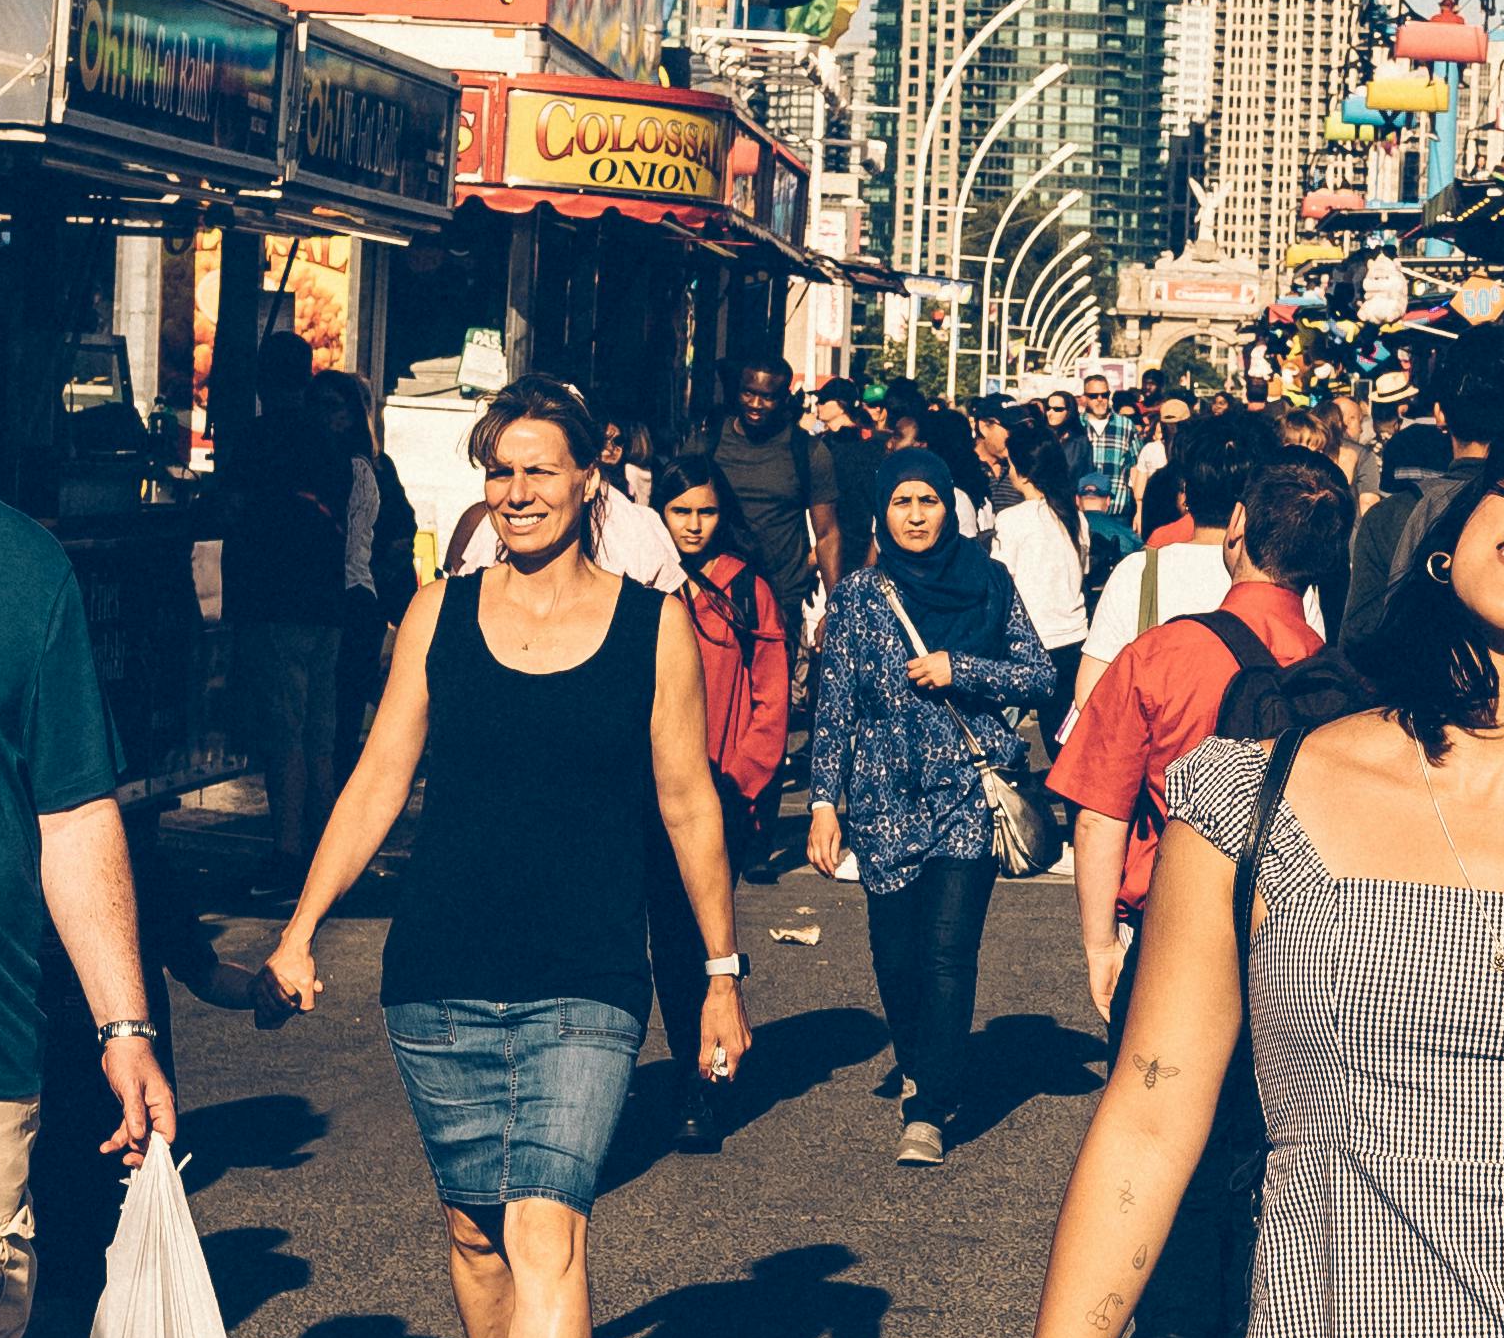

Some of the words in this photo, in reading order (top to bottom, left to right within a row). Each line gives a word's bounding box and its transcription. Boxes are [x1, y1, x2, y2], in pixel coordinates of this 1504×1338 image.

[132, 14, 152, 106] We
[536, 100, 716, 163] COLOSSA
[589, 157, 700, 193] ONION
